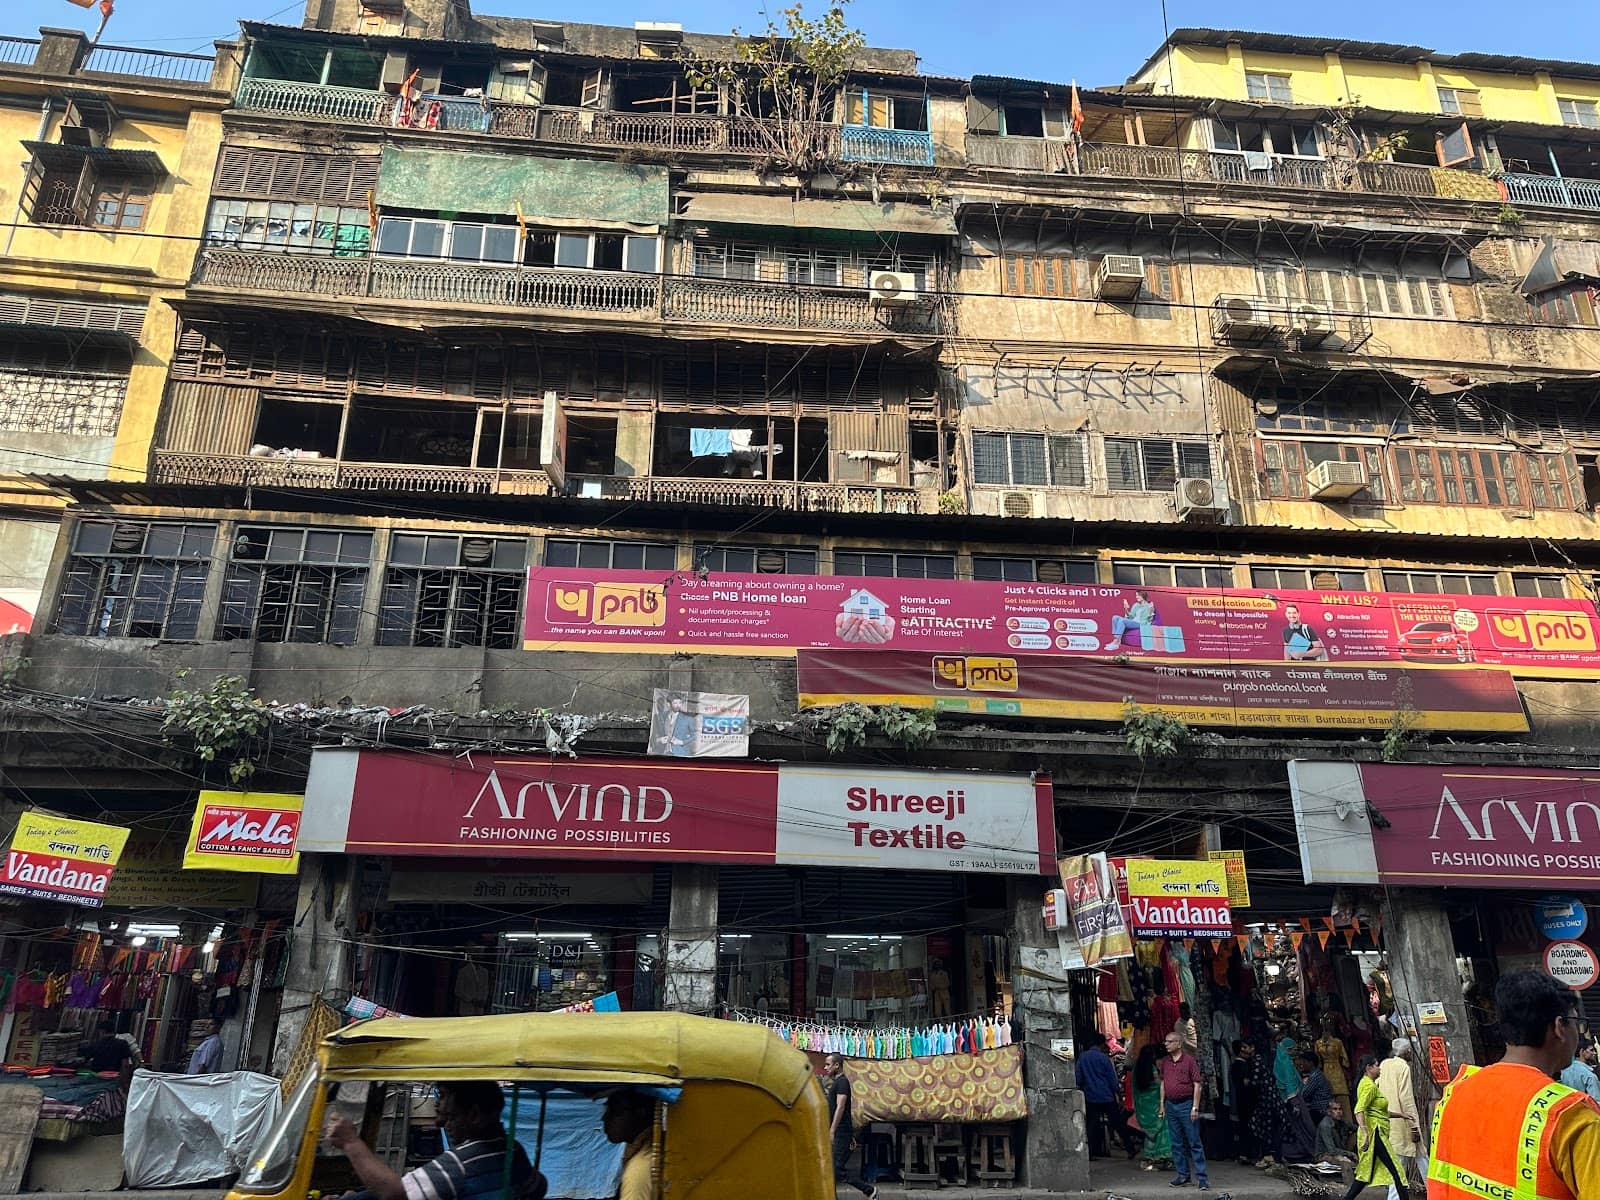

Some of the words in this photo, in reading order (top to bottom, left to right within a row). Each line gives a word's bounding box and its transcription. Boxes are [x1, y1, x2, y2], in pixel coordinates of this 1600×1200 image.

[700, 579, 742, 590] dreaming
[745, 580, 771, 589] about
[773, 582, 805, 592] owning
[816, 583, 845, 591] home?
[1004, 585, 1026, 595] Just
[1027, 586, 1034, 594] 4
[1036, 586, 1067, 596] Clicks
[1069, 588, 1089, 596] and
[1099, 588, 1121, 597] OTP
[681, 592, 710, 601] Choose
[712, 591, 739, 602] PNB
[742, 592, 778, 603] Home
[781, 592, 807, 604] loan
[900, 595, 926, 604] Home
[929, 597, 951, 605] Loan
[1045, 598, 1067, 606] Credit
[1191, 599, 1210, 607] PNB
[1253, 600, 1273, 608] Loan
[1320, 594, 1350, 605] WHY
[1353, 595, 1378, 607] US?
[600, 588, 658, 620] pnb
[900, 605, 936, 615] Starting
[1004, 605, 1049, 613] Pre-Approved
[1051, 606, 1080, 614] Personal
[1398, 603, 1451, 615] OFFERING
[700, 608, 763, 618] upfront/processing
[1416, 614, 1432, 622] BEST
[688, 617, 740, 625] documentation
[619, 628, 641, 636] BANK
[644, 629, 666, 637] upon!
[687, 630, 707, 638] Quick
[724, 631, 744, 639] hassle
[746, 631, 759, 639] free
[761, 632, 789, 640] sanction
[901, 627, 919, 636] Rate
[921, 628, 931, 636] Of
[933, 629, 964, 637] Interest
[1536, 616, 1586, 646] pnb
[971, 662, 1013, 686] pnb
[1223, 682, 1259, 693] punjab
[1260, 682, 1301, 693] national
[1302, 683, 1329, 693] bank
[703, 718, 742, 734] SGS
[1315, 715, 1365, 725] Burrabazar
[847, 787, 965, 821] Shreeji
[55, 828, 78, 836] Choice
[200, 812, 294, 845] Mala
[460, 826, 557, 841] FASHIONING
[564, 829, 671, 844] POSSIBILITIES
[847, 822, 966, 850] Textile
[48, 840, 79, 855] বন্দনা
[84, 844, 112, 861] শাড়ি
[200, 843, 230, 851] COTTON
[263, 847, 291, 855] SAREES
[949, 860, 964, 868] GST
[1431, 851, 1540, 868] FASHIONING
[8, 852, 108, 893] Vandana
[1162, 868, 1182, 878] Choice
[1162, 882, 1191, 893] বন্দনা
[1195, 880, 1220, 895] শাড়ি
[0, 884, 26, 895] SAREES
[32, 890, 52, 899] SUITS
[58, 893, 99, 906] BEDSHEETS
[1132, 897, 1231, 926] Vandana
[1566, 919, 1581, 927] ONLY
[1137, 929, 1163, 937] SAREES
[1193, 930, 1232, 938] BEDSHEETS
[552, 944, 581, 960] D&J
[1551, 949, 1588, 958] BOARDING
[1552, 966, 1594, 976] DEBOARDING
[1520, 1090, 1558, 1180] TRAFFIC
[1456, 1171, 1514, 1200] POLICE
